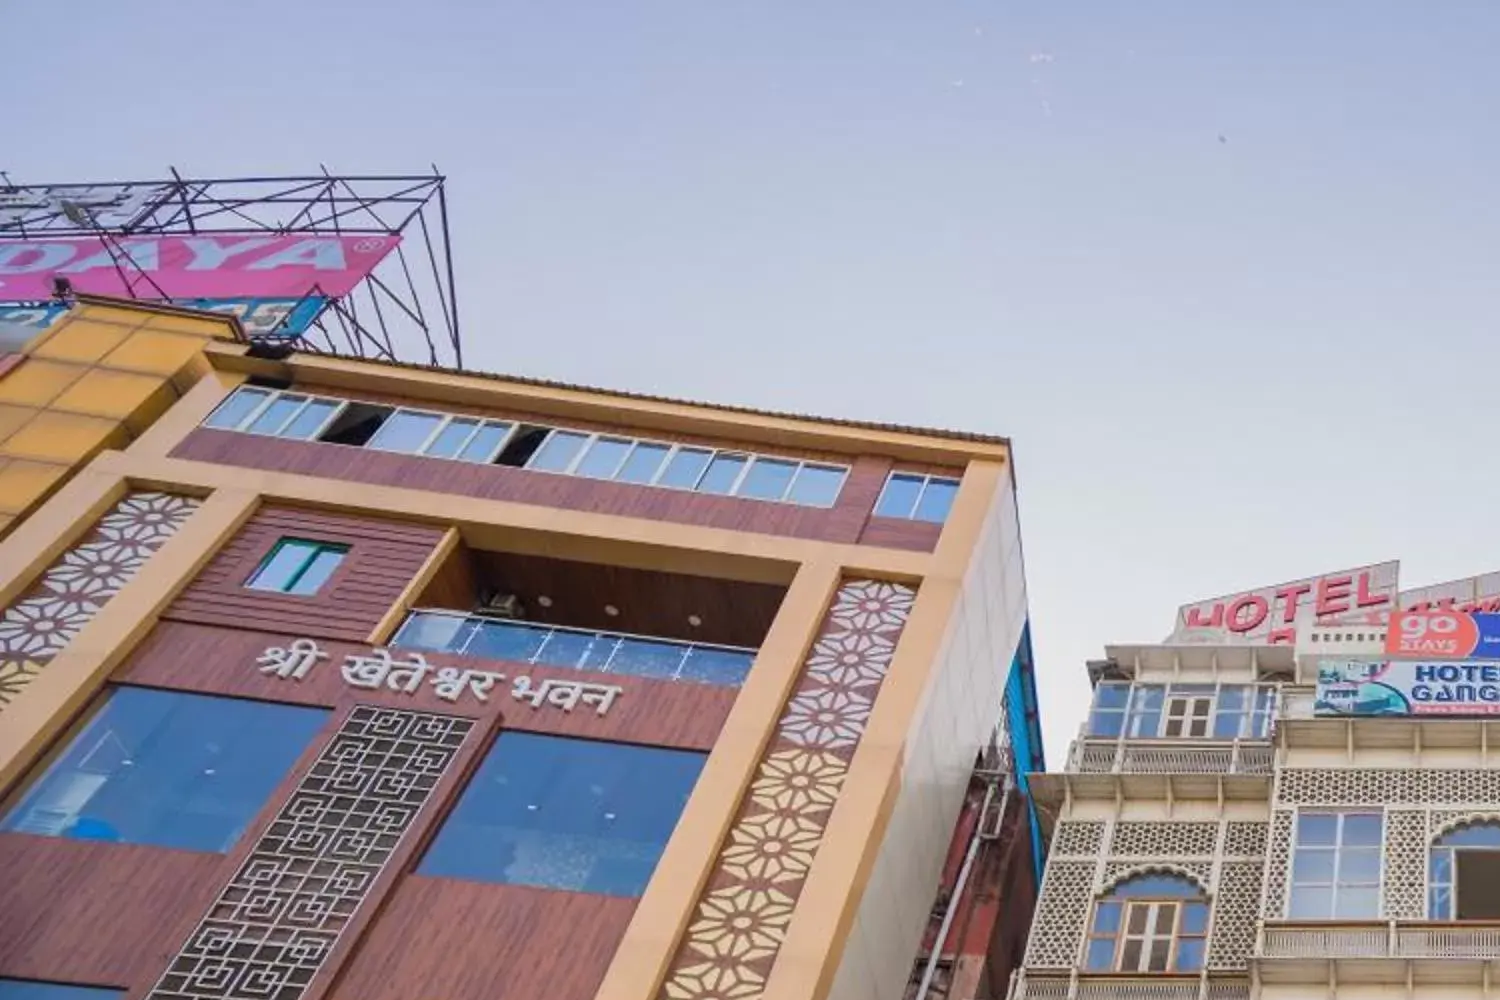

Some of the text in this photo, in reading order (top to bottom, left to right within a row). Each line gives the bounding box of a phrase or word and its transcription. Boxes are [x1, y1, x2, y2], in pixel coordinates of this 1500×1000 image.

[1400, 615, 1458, 639] go
[256, 639, 328, 680] श्री
[511, 674, 623, 715] भवन
